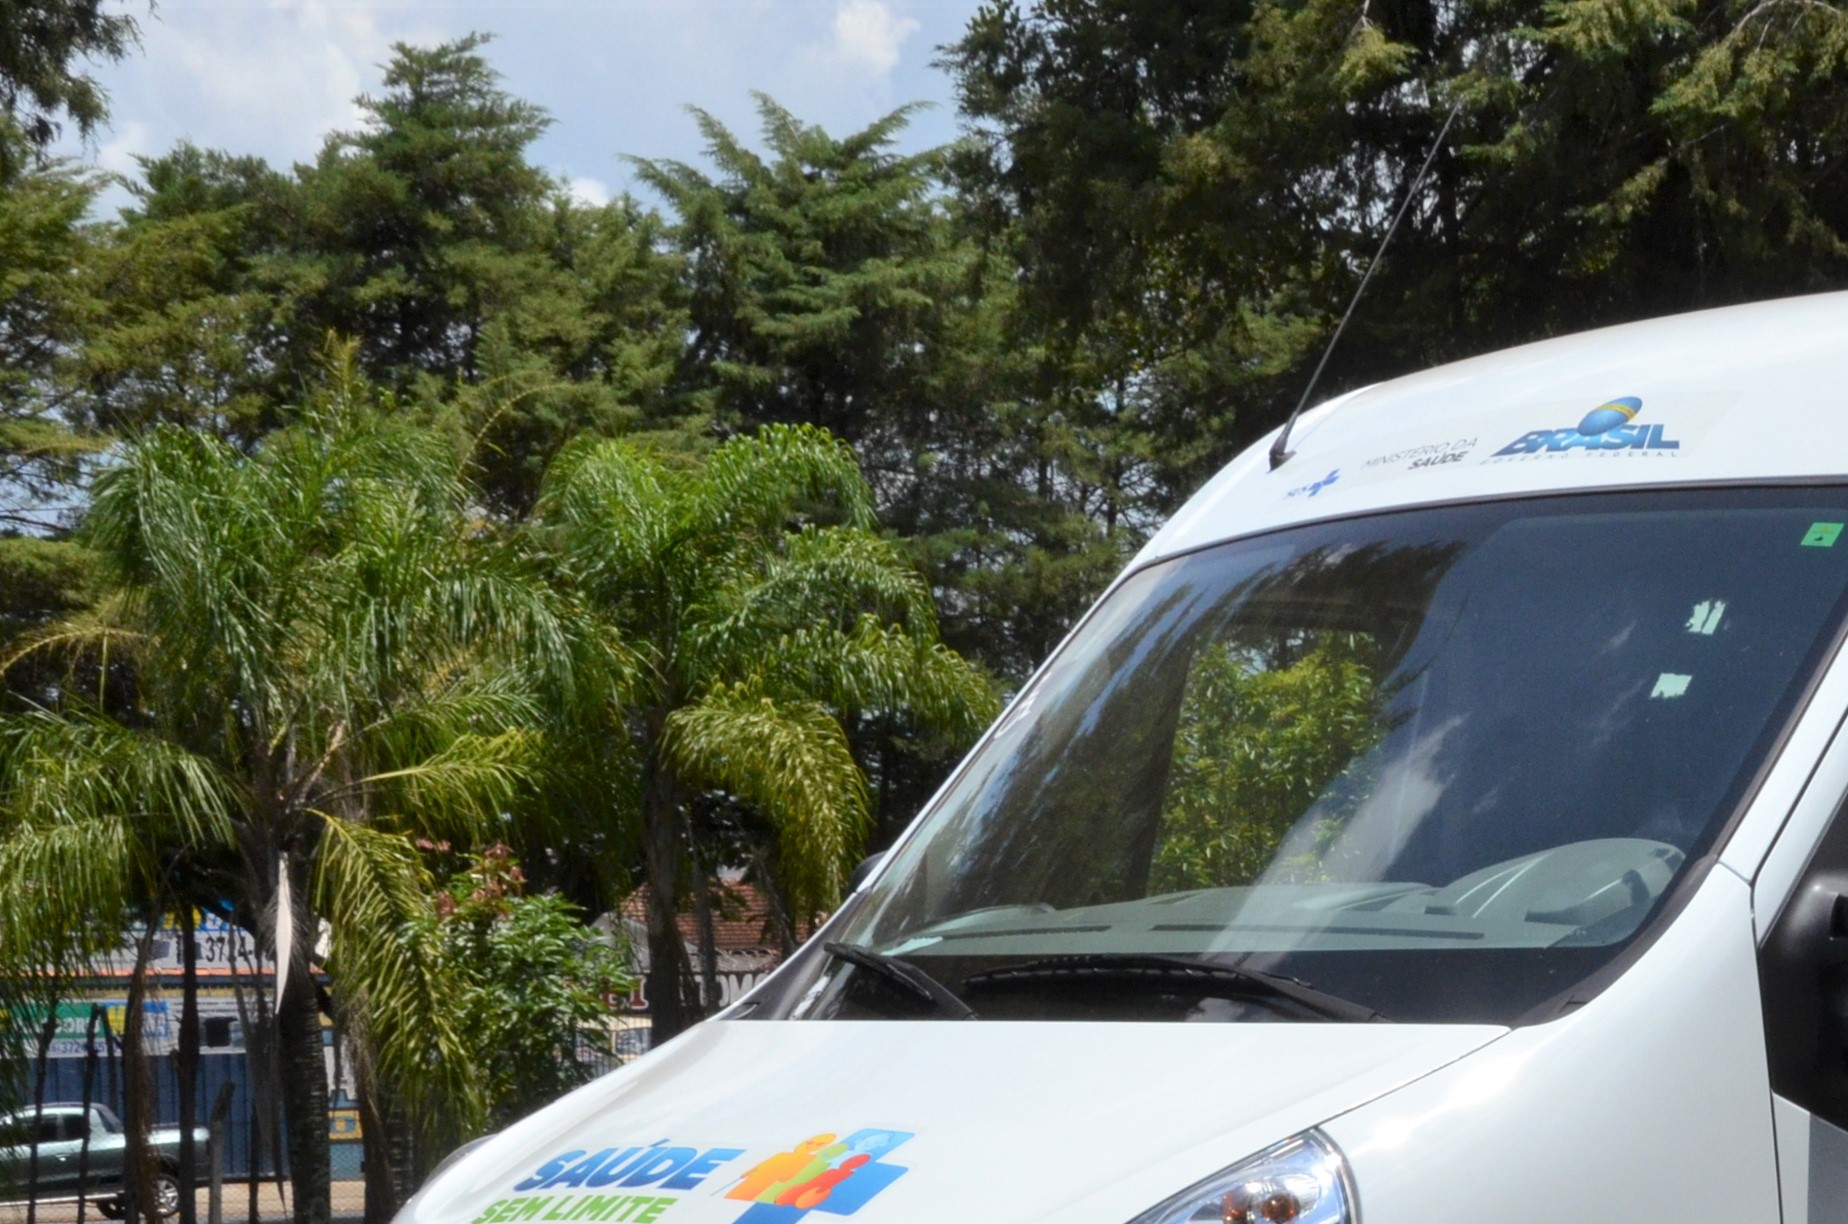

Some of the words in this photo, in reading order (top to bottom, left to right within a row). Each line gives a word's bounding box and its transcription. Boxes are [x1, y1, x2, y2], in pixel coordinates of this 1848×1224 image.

[1490, 424, 1680, 457] BRASIL
[513, 1138, 746, 1191] SAÚDE
[471, 1197, 550, 1224] SEM
[540, 1195, 678, 1224] LIMITE
